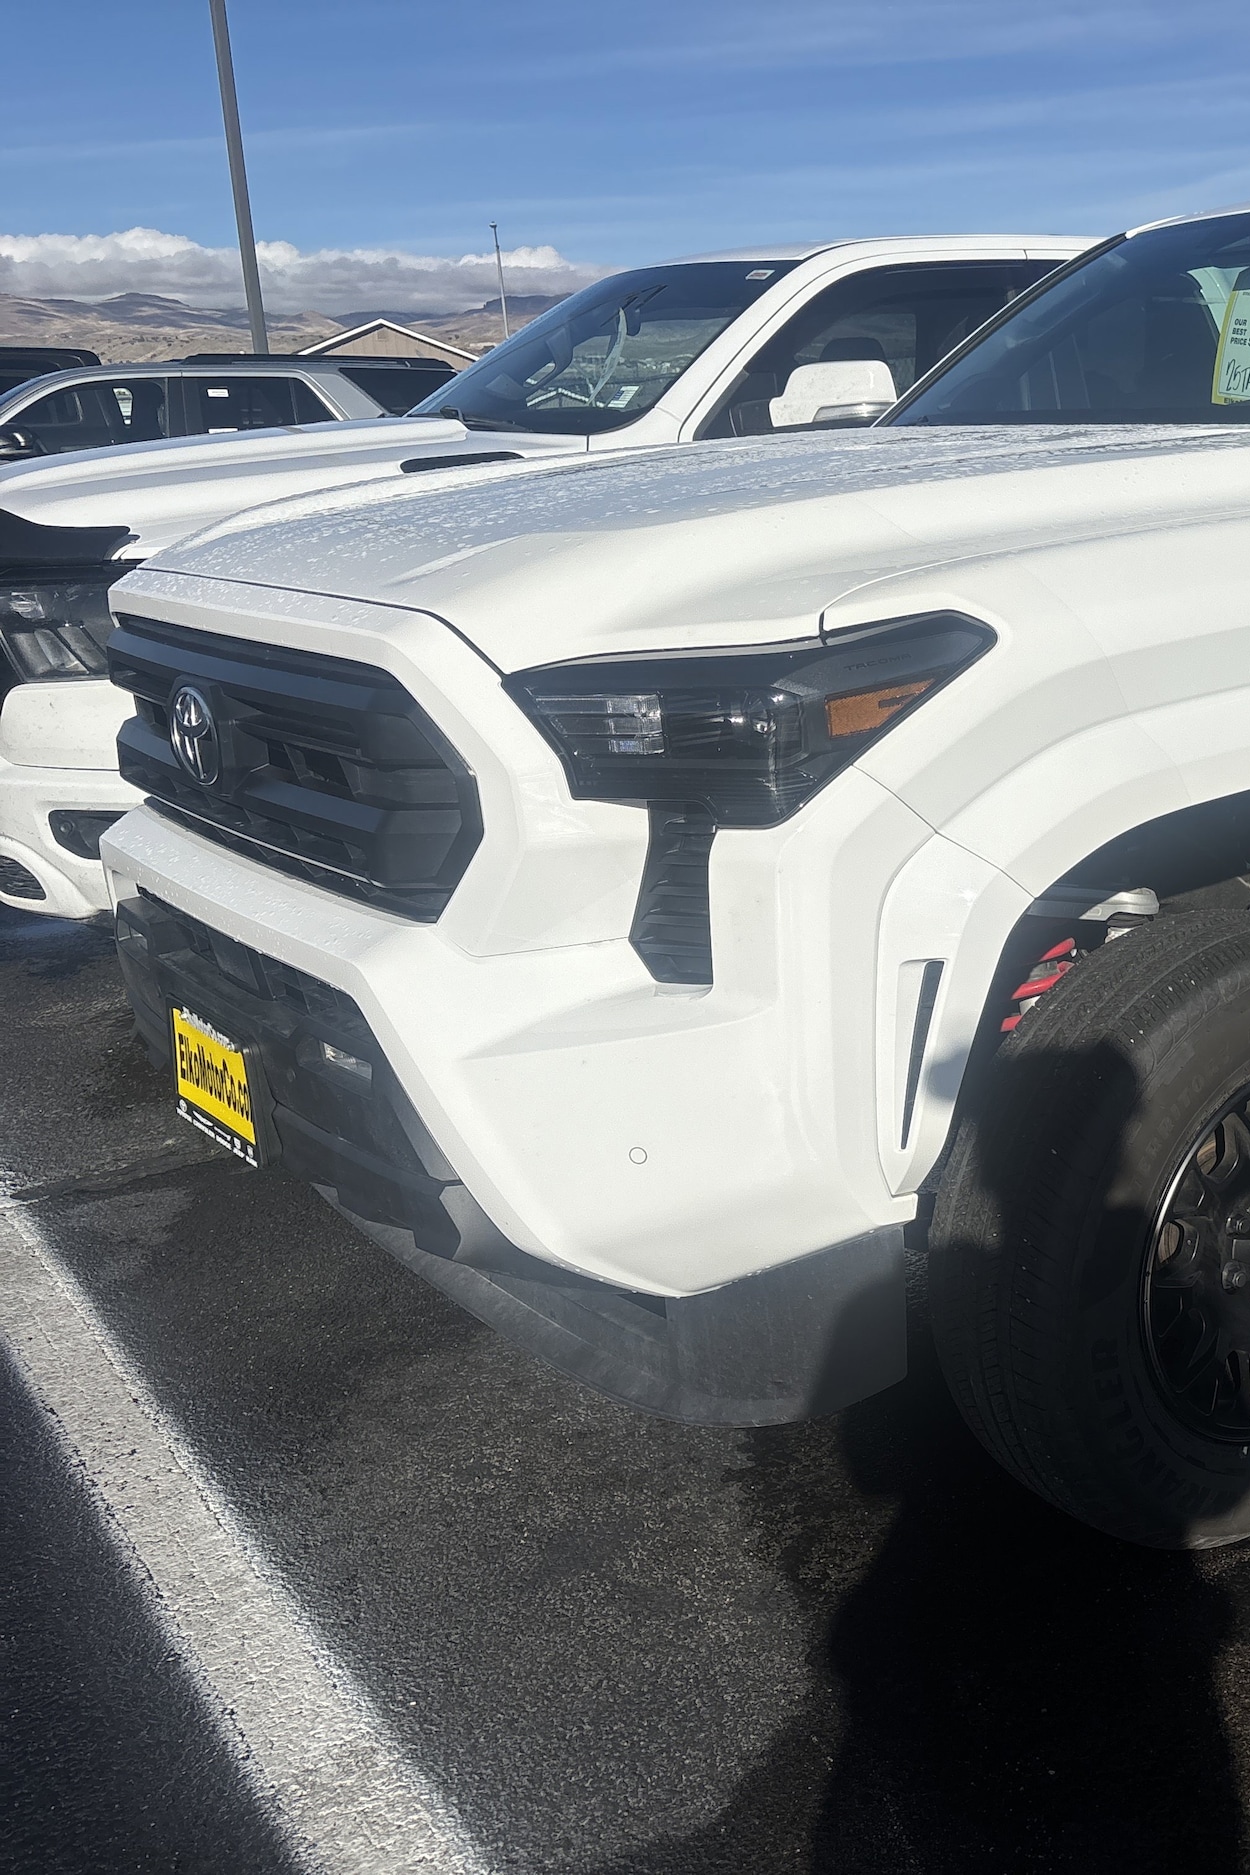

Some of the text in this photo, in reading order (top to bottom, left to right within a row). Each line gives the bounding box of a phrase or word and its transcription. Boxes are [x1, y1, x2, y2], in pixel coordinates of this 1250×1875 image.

[1235, 318, 1248, 326] OUR
[1232, 328, 1247, 336] BEST
[1230, 337, 1247, 346] PRICE
[843, 653, 912, 671] TACOMA
[178, 1032, 253, 1124] ElkoMotorCo.co
